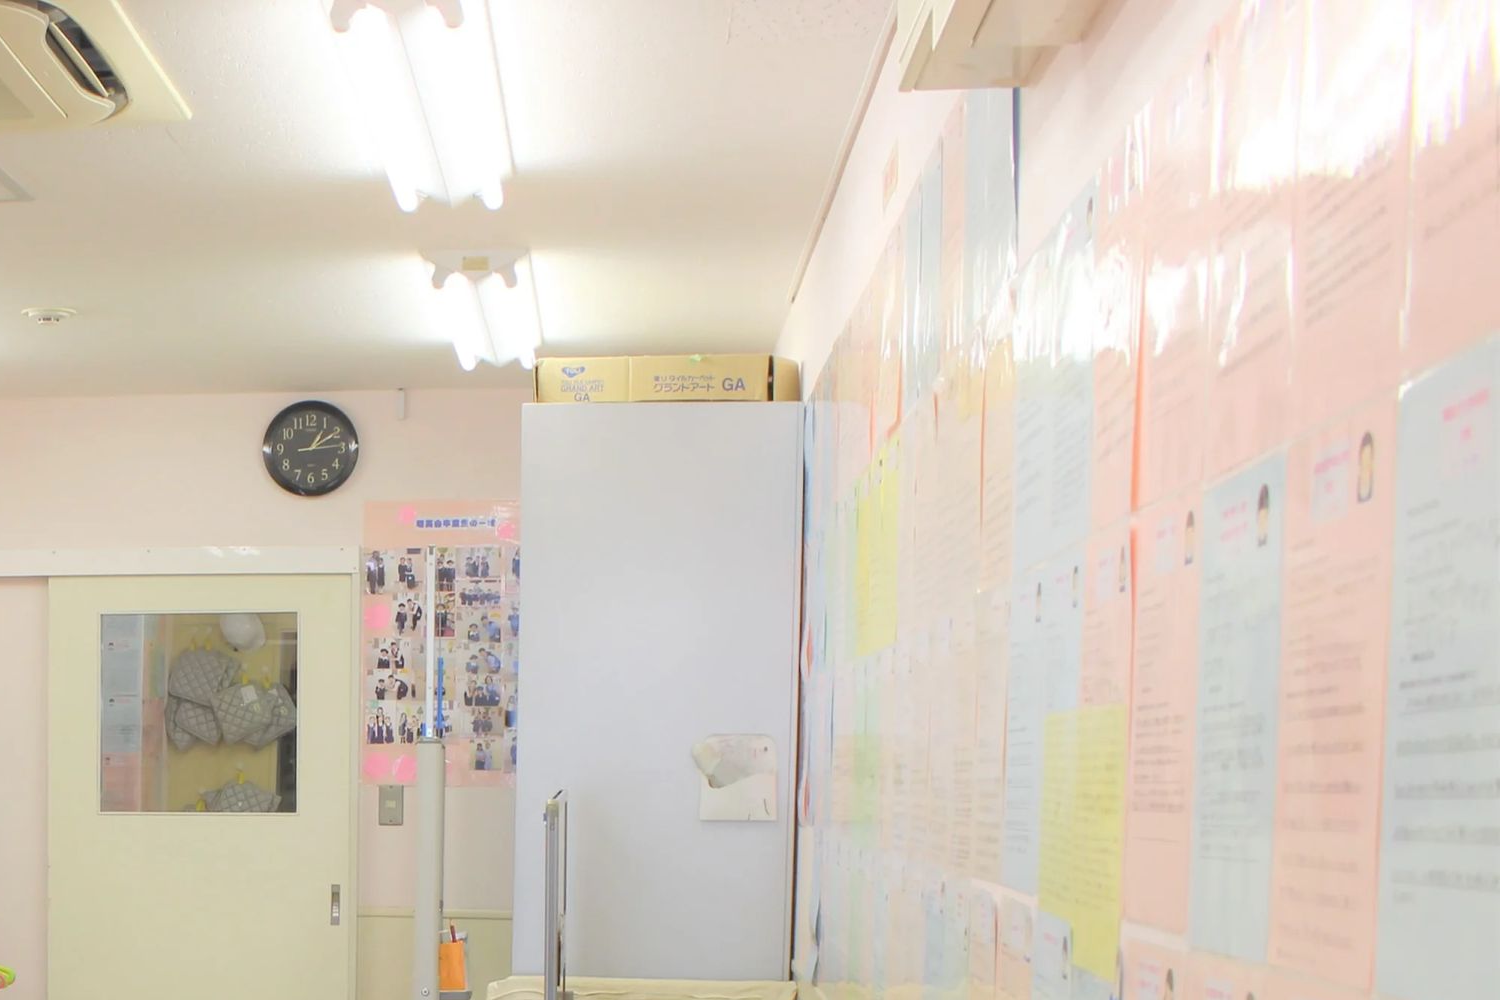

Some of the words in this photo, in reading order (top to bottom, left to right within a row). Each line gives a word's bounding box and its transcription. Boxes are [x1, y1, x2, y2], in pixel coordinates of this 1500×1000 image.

[722, 377, 746, 391] GA
[574, 393, 590, 401] GA
[293, 417, 303, 429] 11
[306, 414, 317, 427] 12
[283, 428, 294, 440] 10
[333, 426, 341, 438] 2
[276, 443, 284, 455] 9
[337, 442, 346, 454] 3
[282, 458, 290, 471] 8
[332, 458, 340, 470] 4
[294, 469, 302, 481] 7
[307, 472, 315, 484] 6
[321, 468, 329, 481] 5
